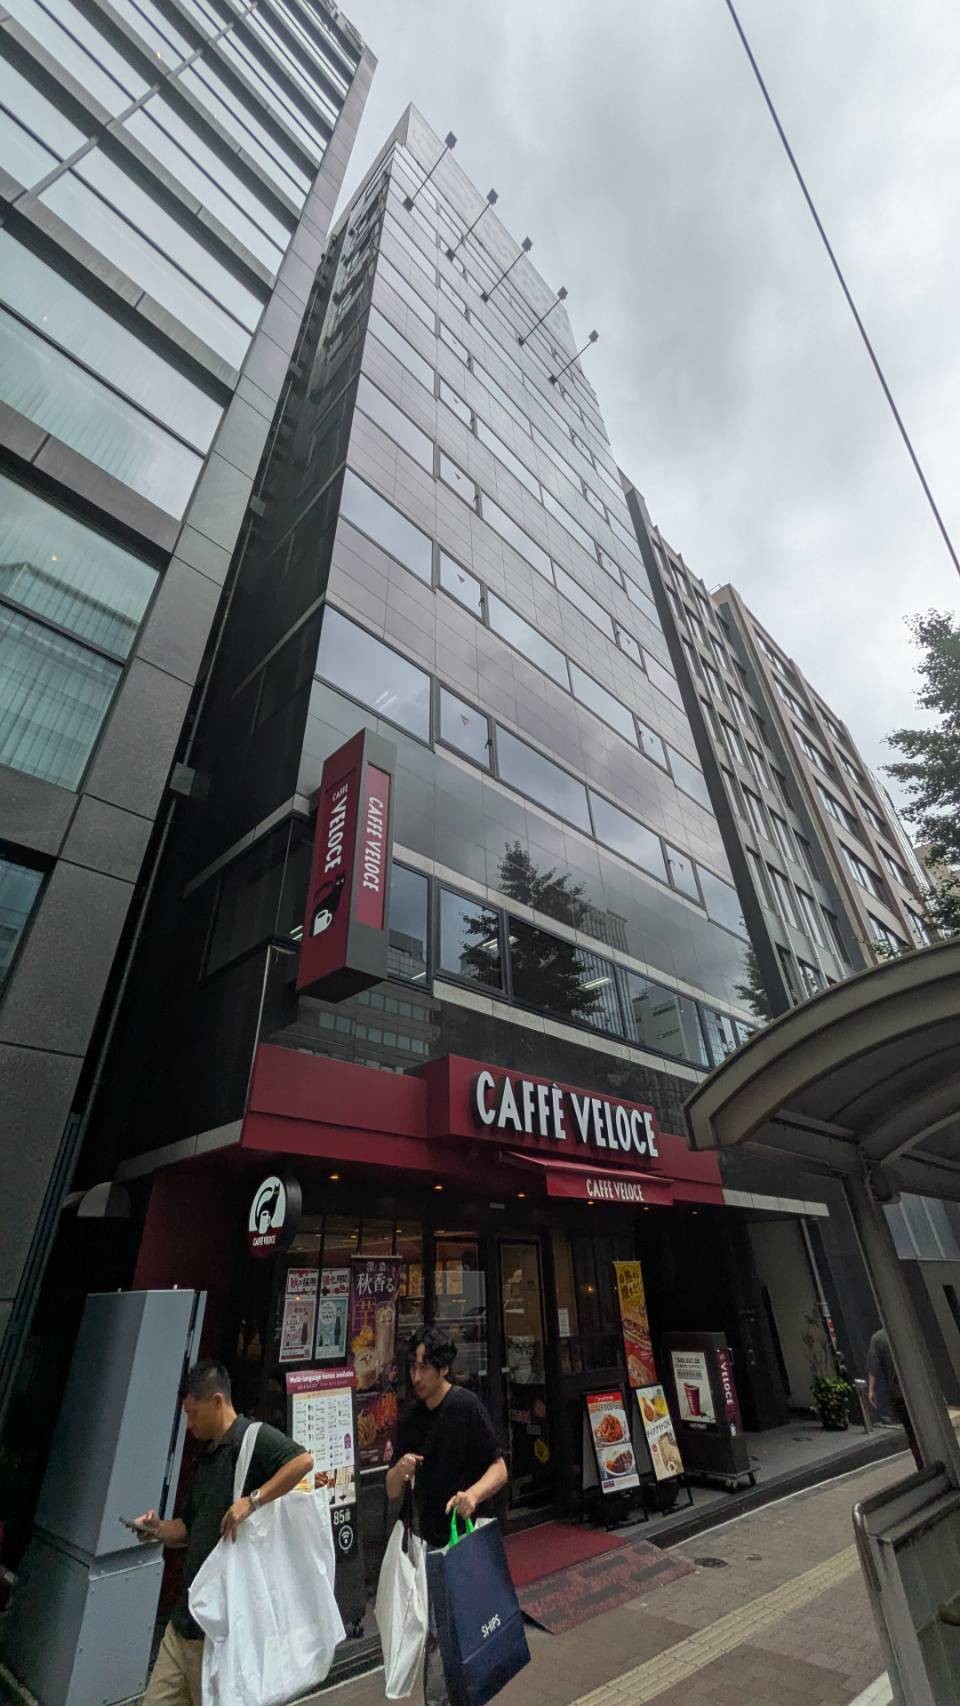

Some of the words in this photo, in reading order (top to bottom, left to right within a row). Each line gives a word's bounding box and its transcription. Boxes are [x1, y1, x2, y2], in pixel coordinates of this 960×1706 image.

[324, 796, 347, 873] VELOCE
[363, 840, 381, 892] VELOCE
[475, 1070, 566, 1140] CAFFÈ
[570, 1092, 660, 1158] VELOCE
[613, 1182, 645, 1201] VELOCE
[356, 1272, 394, 1296] 秋香る
[720, 1362, 734, 1405] VELOCE
[481, 1613, 502, 1638] SHIPS
